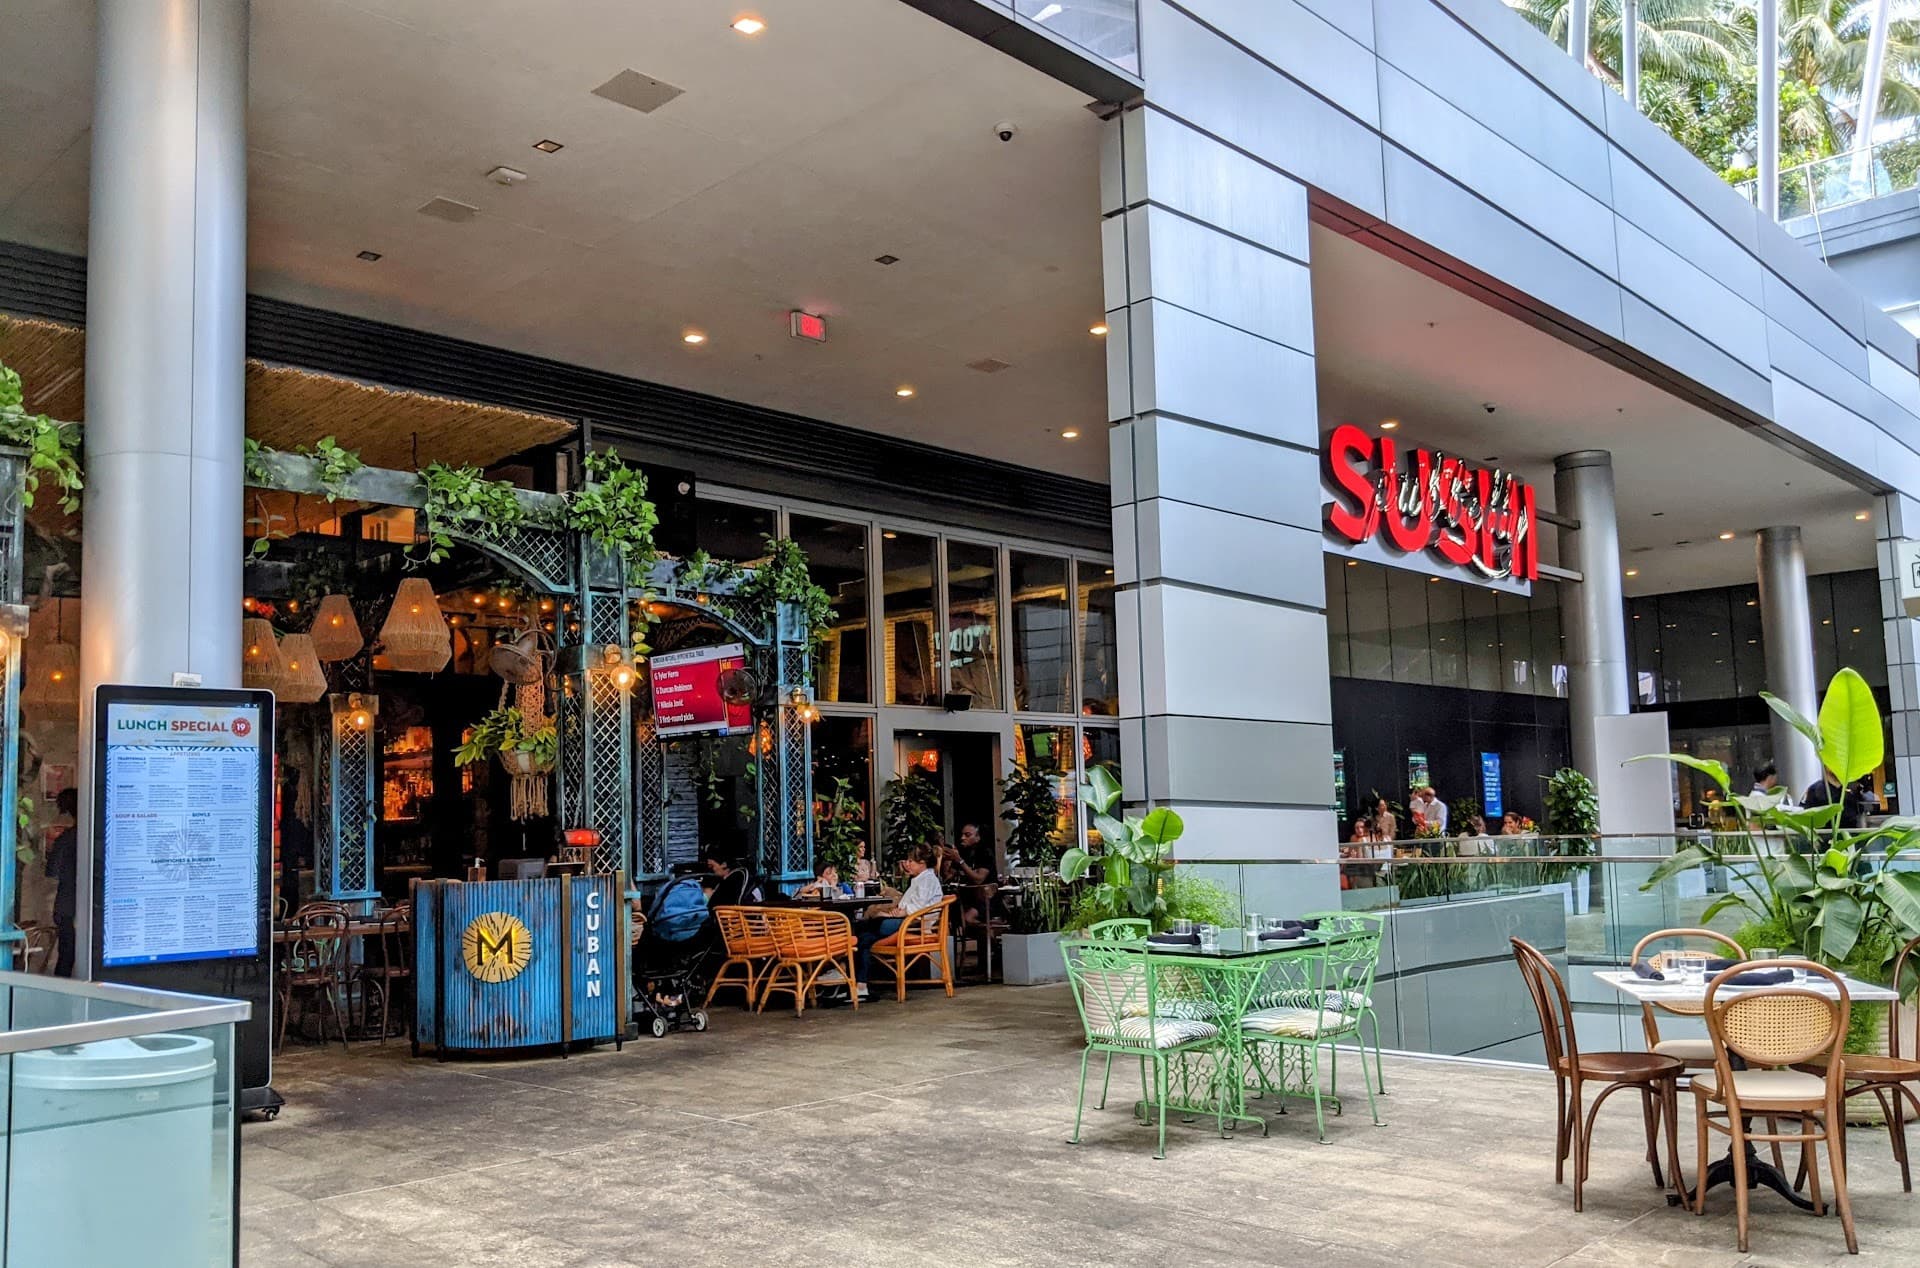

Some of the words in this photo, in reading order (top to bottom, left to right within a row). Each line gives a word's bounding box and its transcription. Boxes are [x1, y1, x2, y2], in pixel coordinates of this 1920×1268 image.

[1330, 424, 1539, 581] SUSHI
[658, 671, 668, 680] Tyler
[660, 686, 674, 694] Duncan
[674, 683, 693, 691] Robinson
[660, 700, 674, 709] Nikola
[684, 712, 694, 722] picks
[117, 719, 167, 731] LUNCH
[171, 720, 229, 733] SPECIAL
[237, 722, 246, 731] 19
[476, 925, 514, 966] M
[586, 892, 601, 998] CUBAN
